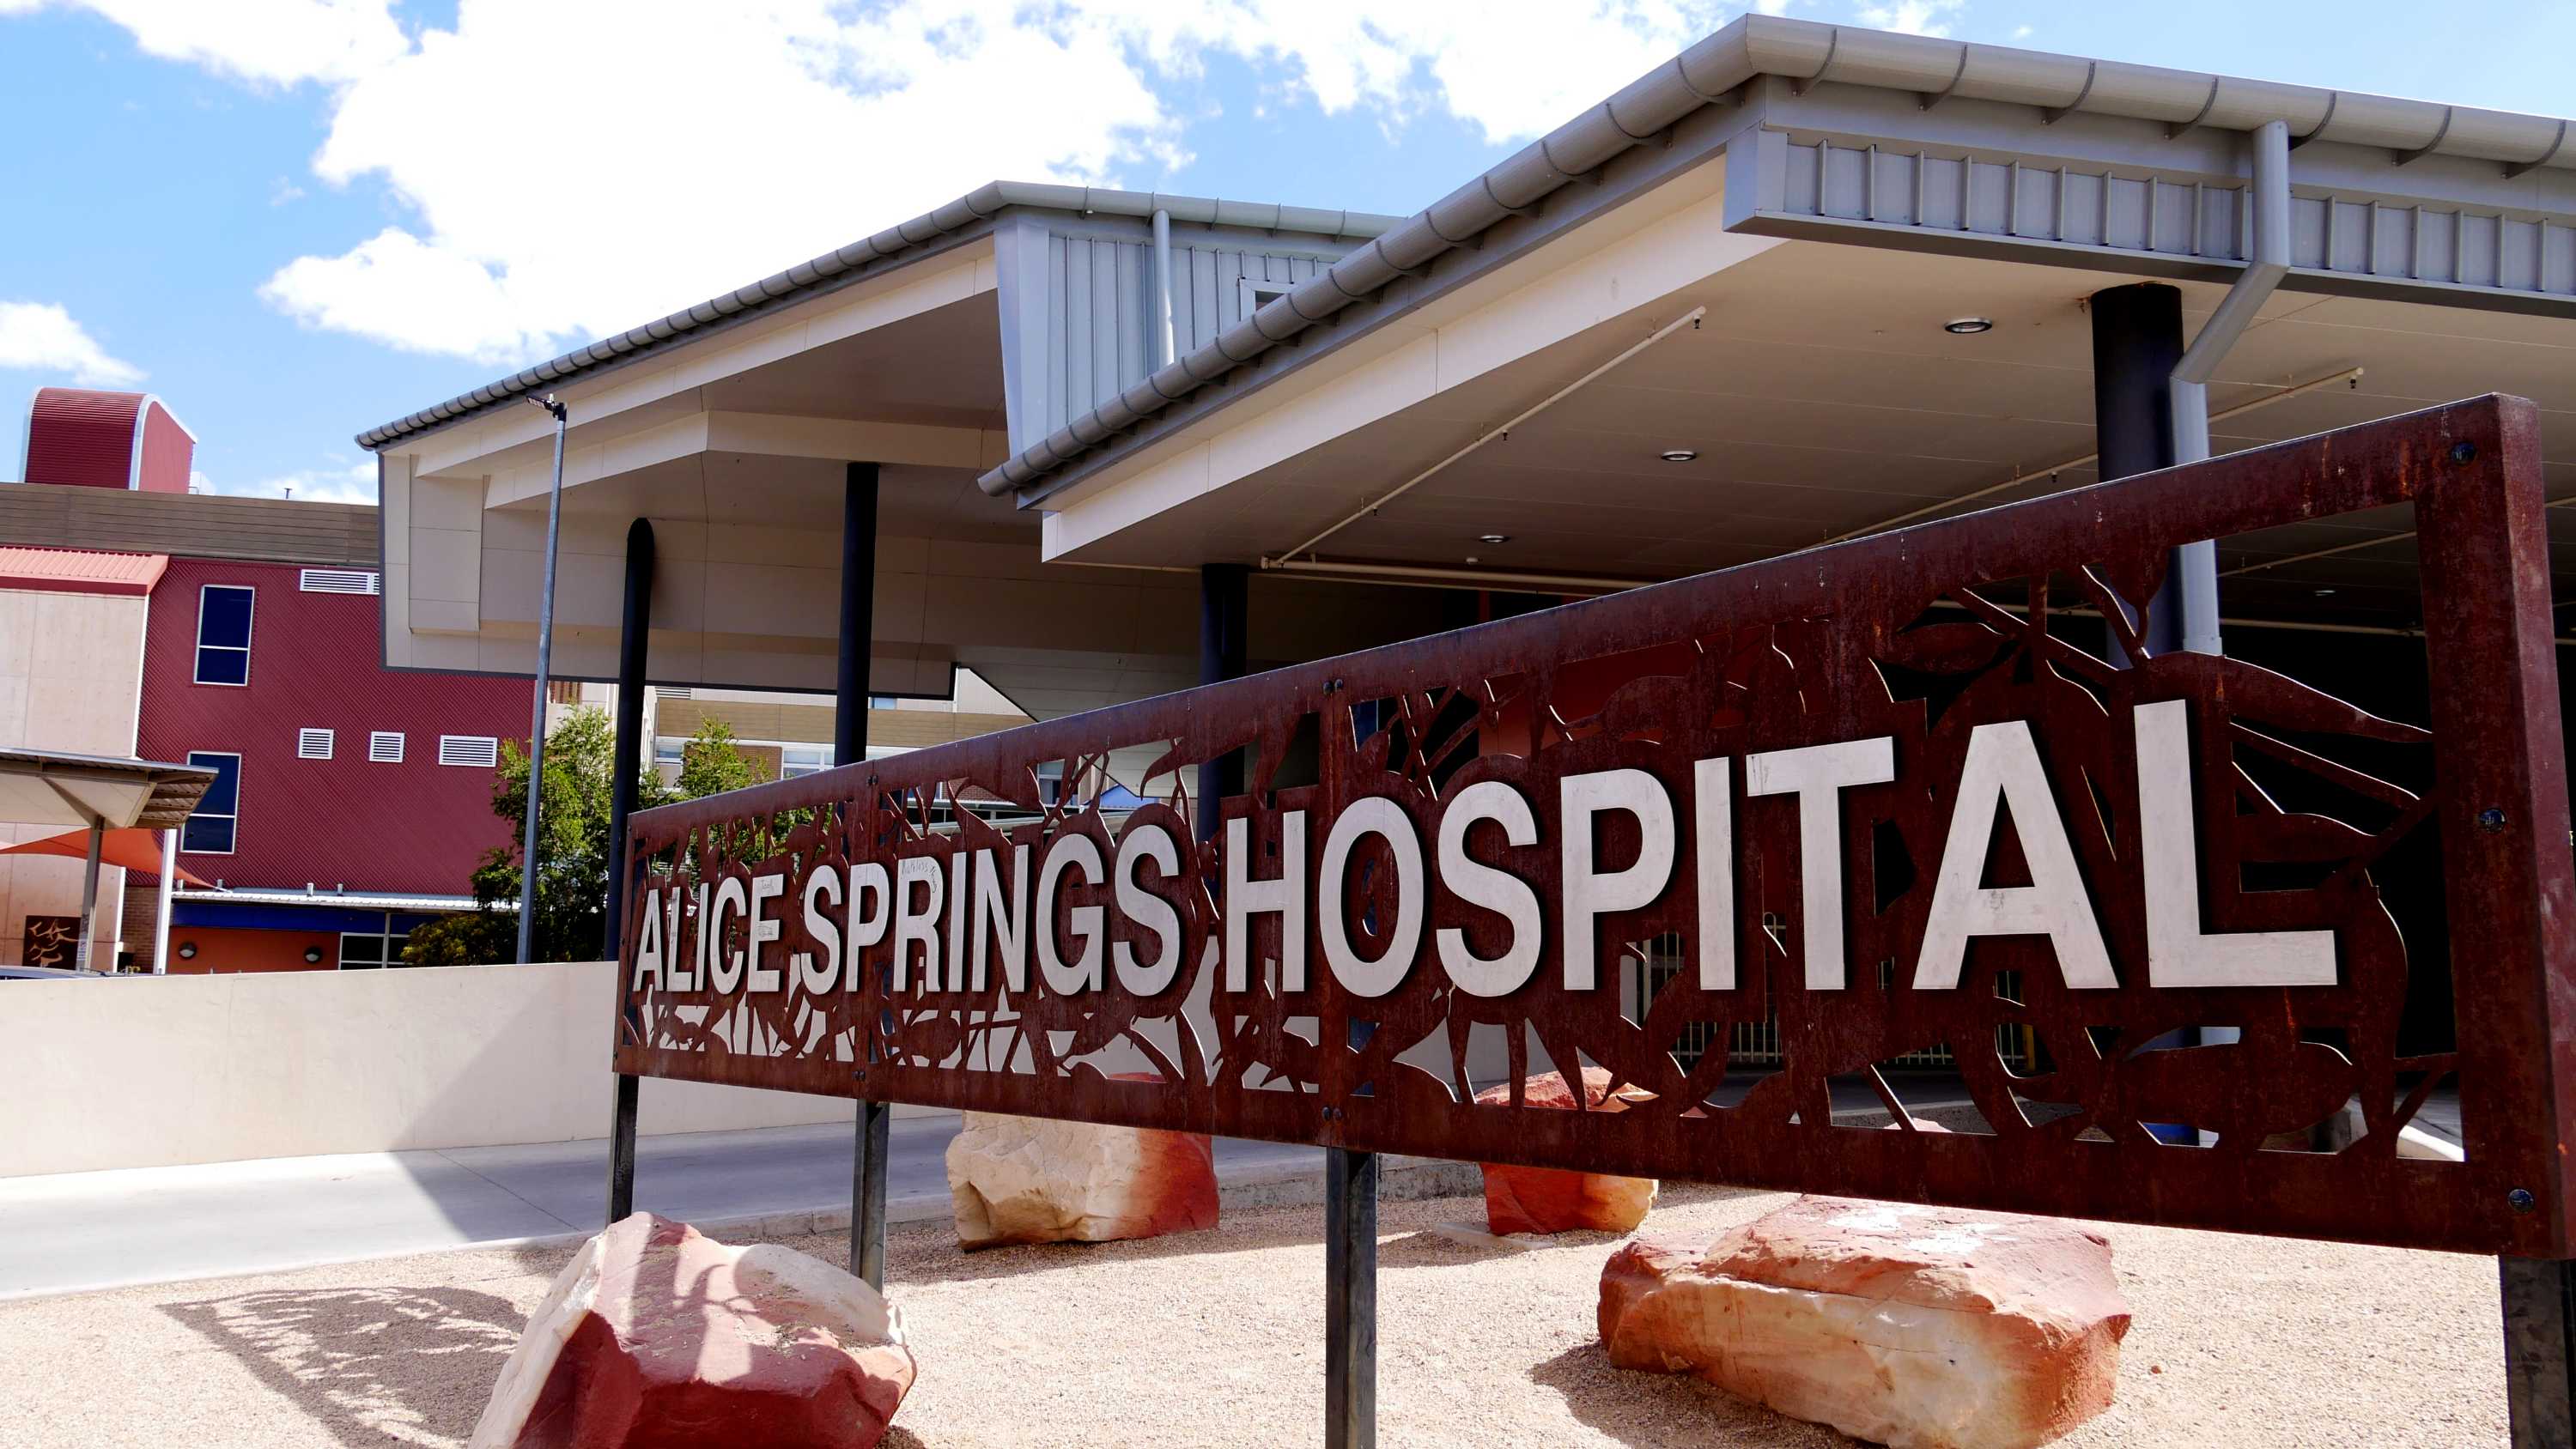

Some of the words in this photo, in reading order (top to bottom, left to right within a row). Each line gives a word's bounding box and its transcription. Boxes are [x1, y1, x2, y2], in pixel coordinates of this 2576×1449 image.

[633, 873, 784, 995] ALICE
[799, 824, 1180, 997] SPRINGS
[1225, 699, 2337, 997] HOSPITAL
